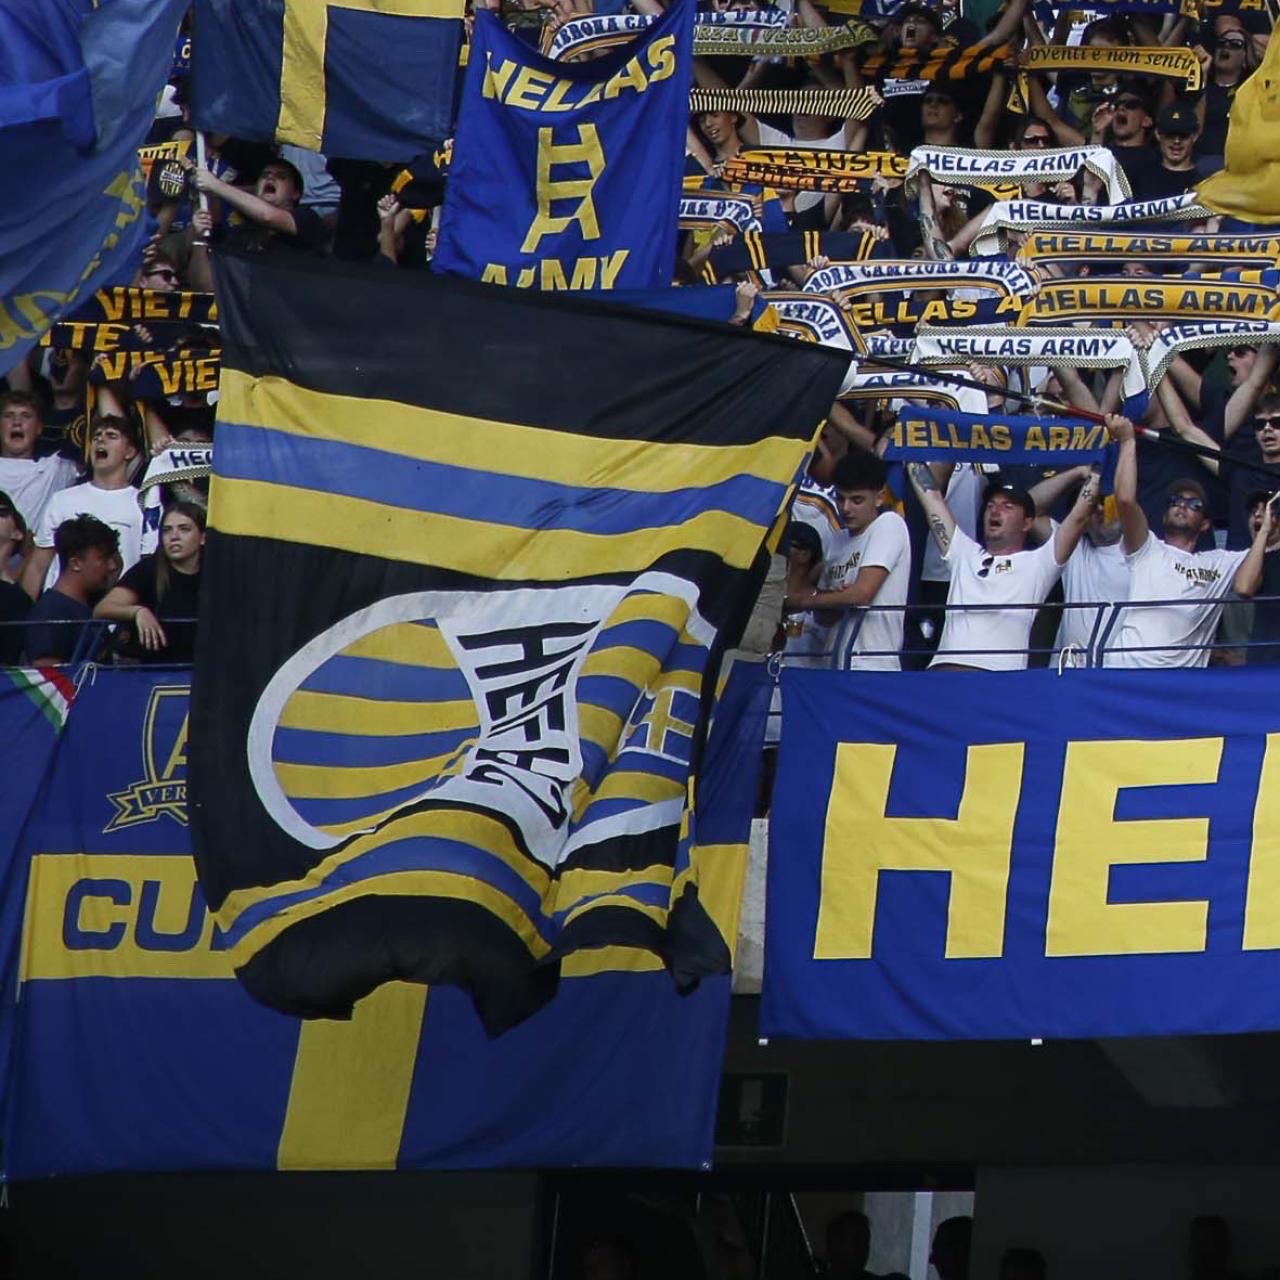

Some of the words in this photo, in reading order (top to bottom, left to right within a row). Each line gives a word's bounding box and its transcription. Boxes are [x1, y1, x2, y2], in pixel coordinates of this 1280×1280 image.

[1107, 51, 1141, 65] non
[1144, 52, 1195, 70] sentir
[925, 153, 1020, 174] HELLAS
[1008, 202, 1103, 223] HELLAS
[1112, 196, 1187, 221] ARMY
[1036, 232, 1173, 254] HELLAS
[852, 299, 977, 327] ELLAS
[1035, 289, 1160, 314] HELLAS
[1180, 287, 1279, 315] ARMY
[1161, 322, 1270, 347] HELLAS
[938, 339, 1032, 357] HELLAS
[1040, 338, 1118, 358] ARMY
[891, 421, 1012, 450] HELLAS
[144, 786, 188, 804] VER
[62, 877, 222, 953] CU
